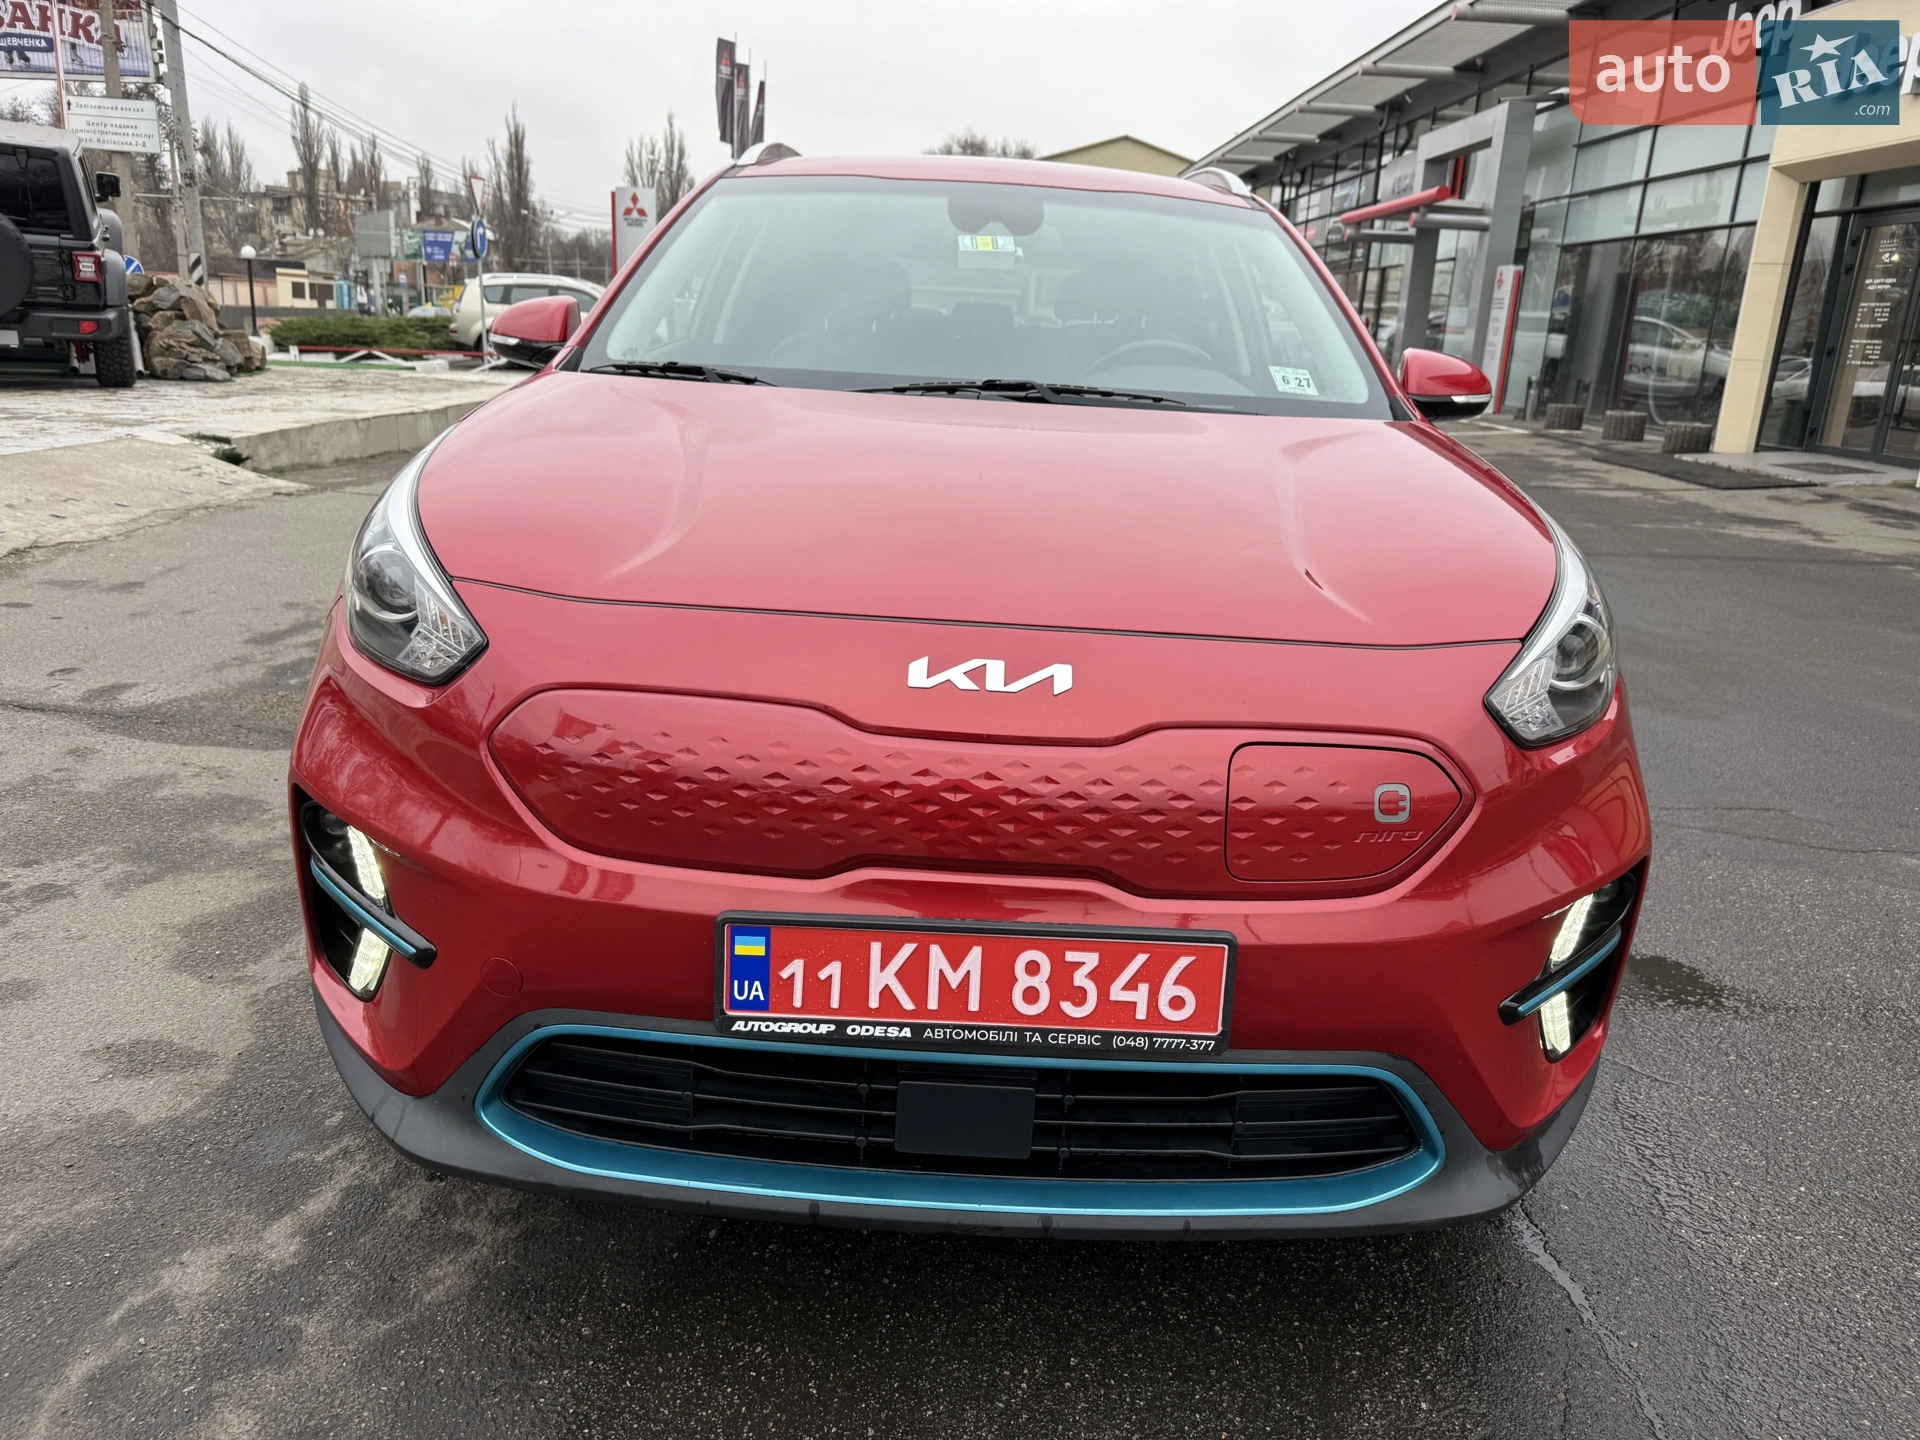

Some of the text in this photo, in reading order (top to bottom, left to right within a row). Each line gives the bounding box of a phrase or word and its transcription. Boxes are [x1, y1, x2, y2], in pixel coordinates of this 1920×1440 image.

[1710, 0, 1802, 57] Jeep
[75, 101, 119, 111] Залізничний
[86, 120, 108, 128] Центр
[1281, 375, 1311, 388] 6 27
[907, 656, 1073, 697] KIA
[733, 980, 765, 1001] UA
[778, 941, 1197, 1022] 11 KM 8346
[731, 1020, 1216, 1051] AUTOGROUP ODESA АВТОМОБІЛІ ТА СЕРВІС (048) 7777-377
